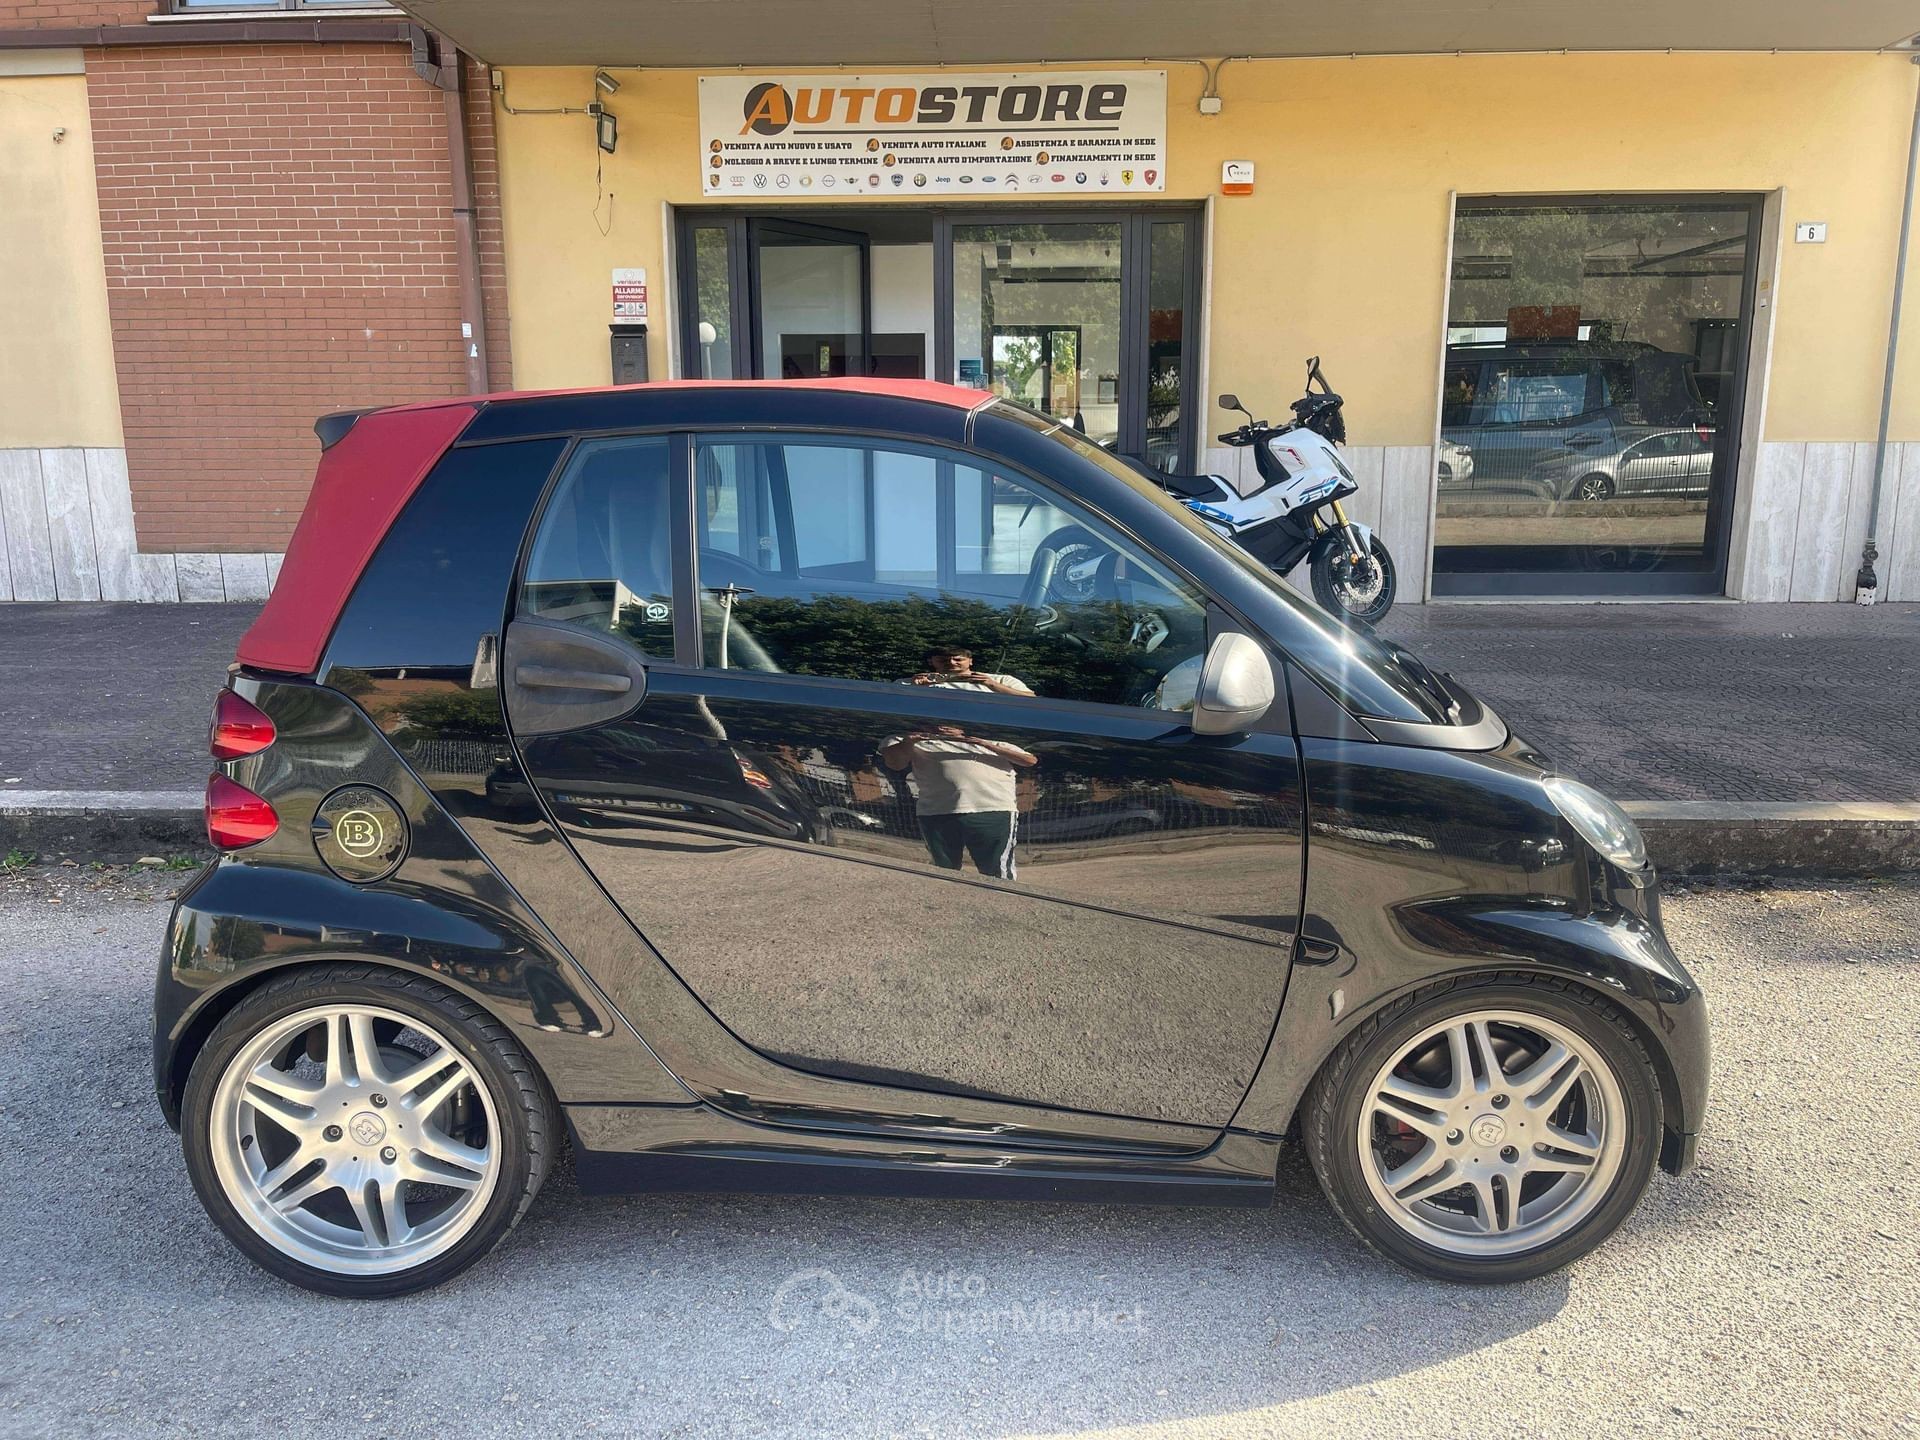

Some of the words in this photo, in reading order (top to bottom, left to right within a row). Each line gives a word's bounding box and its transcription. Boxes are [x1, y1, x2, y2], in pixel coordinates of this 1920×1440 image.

[824, 142, 852, 150] USATO
[881, 141, 920, 149] VENDITA
[921, 141, 944, 149] AUTO
[945, 140, 987, 148] ITALIANE
[1015, 139, 1068, 148] ASSISTENZA
[1070, 139, 1076, 147] E
[1077, 138, 1121, 146] GARANZIA
[1122, 138, 1133, 146] IN
[1134, 138, 1156, 146] SEDE
[724, 158, 764, 166] NOLEGGIO
[765, 158, 772, 166] A
[838, 157, 879, 165] TERMINE
[897, 156, 936, 164] VENDITA
[937, 156, 960, 164] AUTO
[961, 155, 1033, 163] D'IMPORTAZIONE
[1051, 154, 1121, 162] FINANZIAMENTI
[1123, 153, 1133, 161] IN
[1134, 153, 1156, 161] SEDE
[1808, 226, 1815, 240] 6
[344, 820, 375, 847] B
